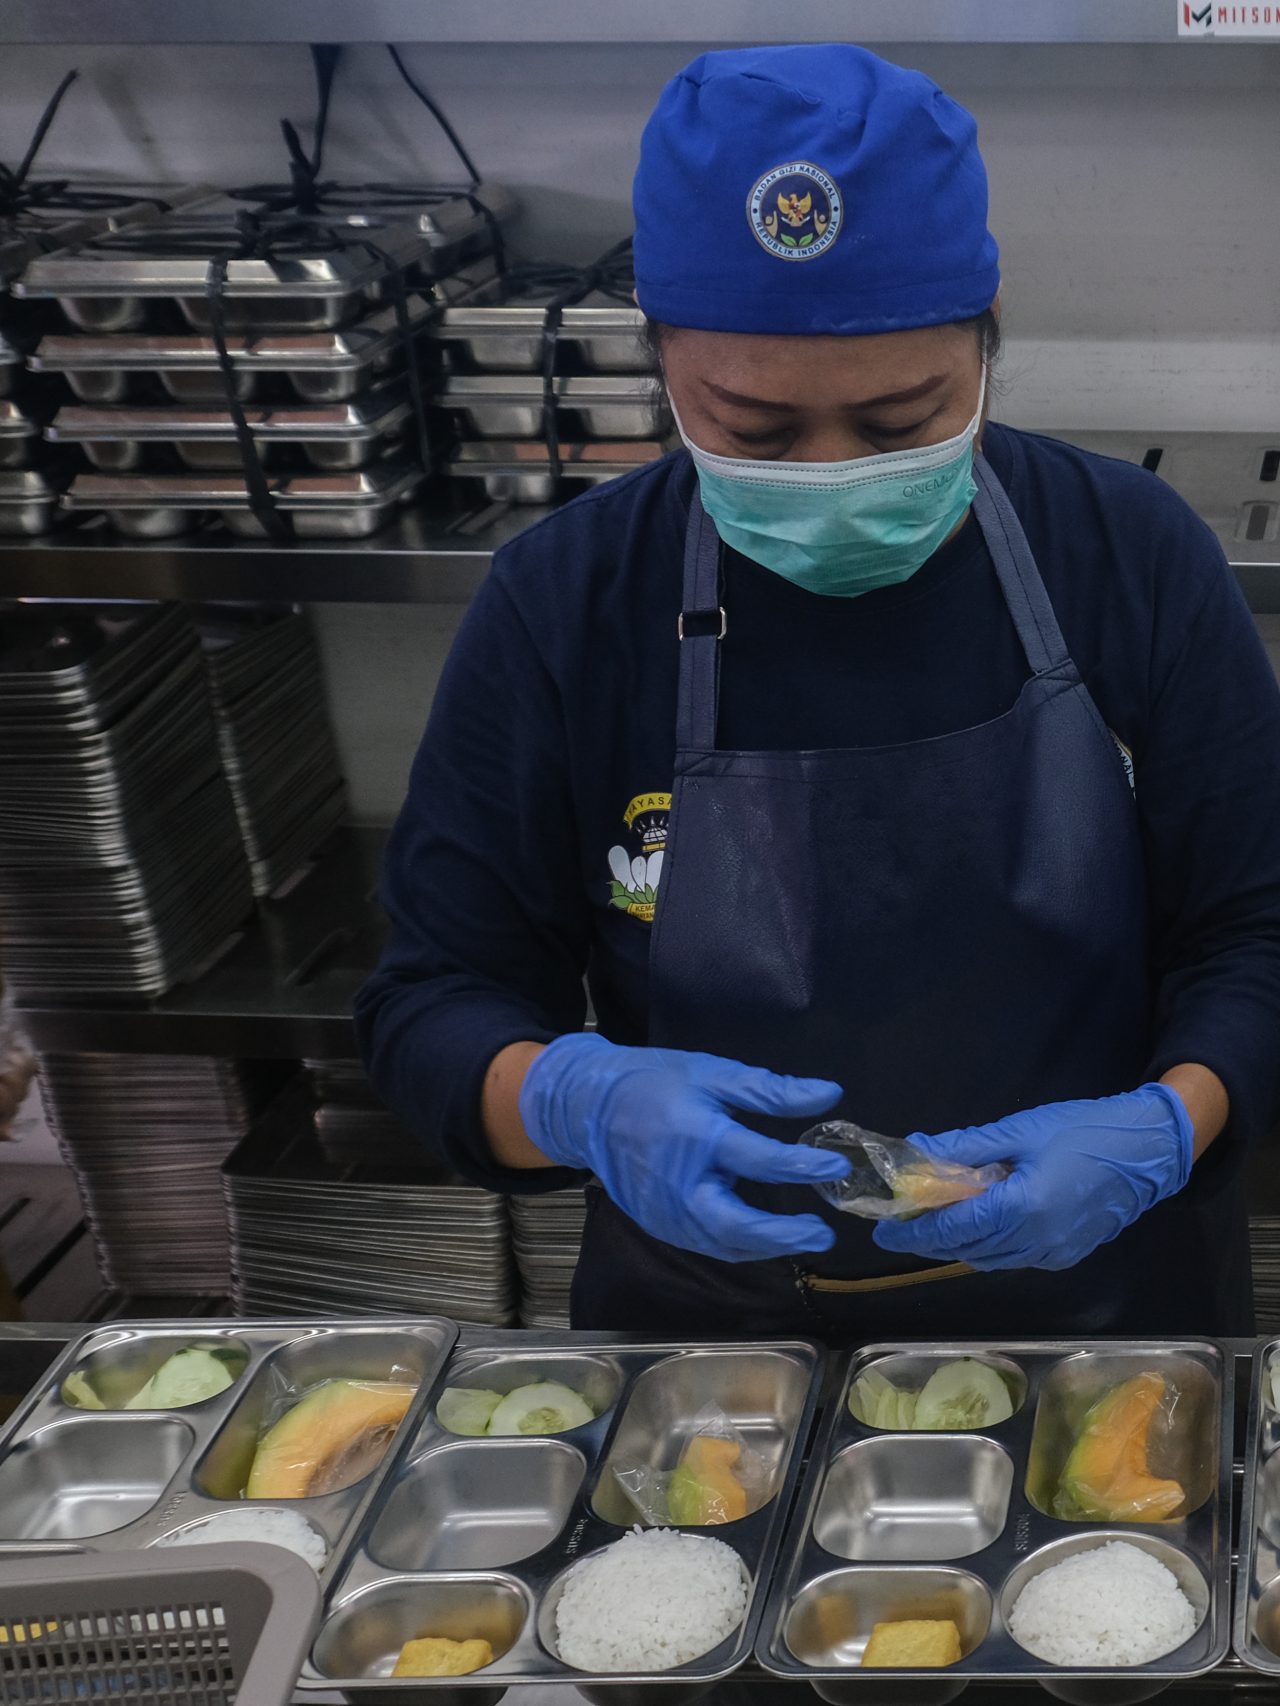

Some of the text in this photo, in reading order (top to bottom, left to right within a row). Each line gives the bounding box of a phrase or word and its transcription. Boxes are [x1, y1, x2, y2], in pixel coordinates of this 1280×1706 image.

[754, 165, 836, 201] BADAN GIZI NASIONAL
[756, 220, 838, 256] REPUBLIK INDONESIA
